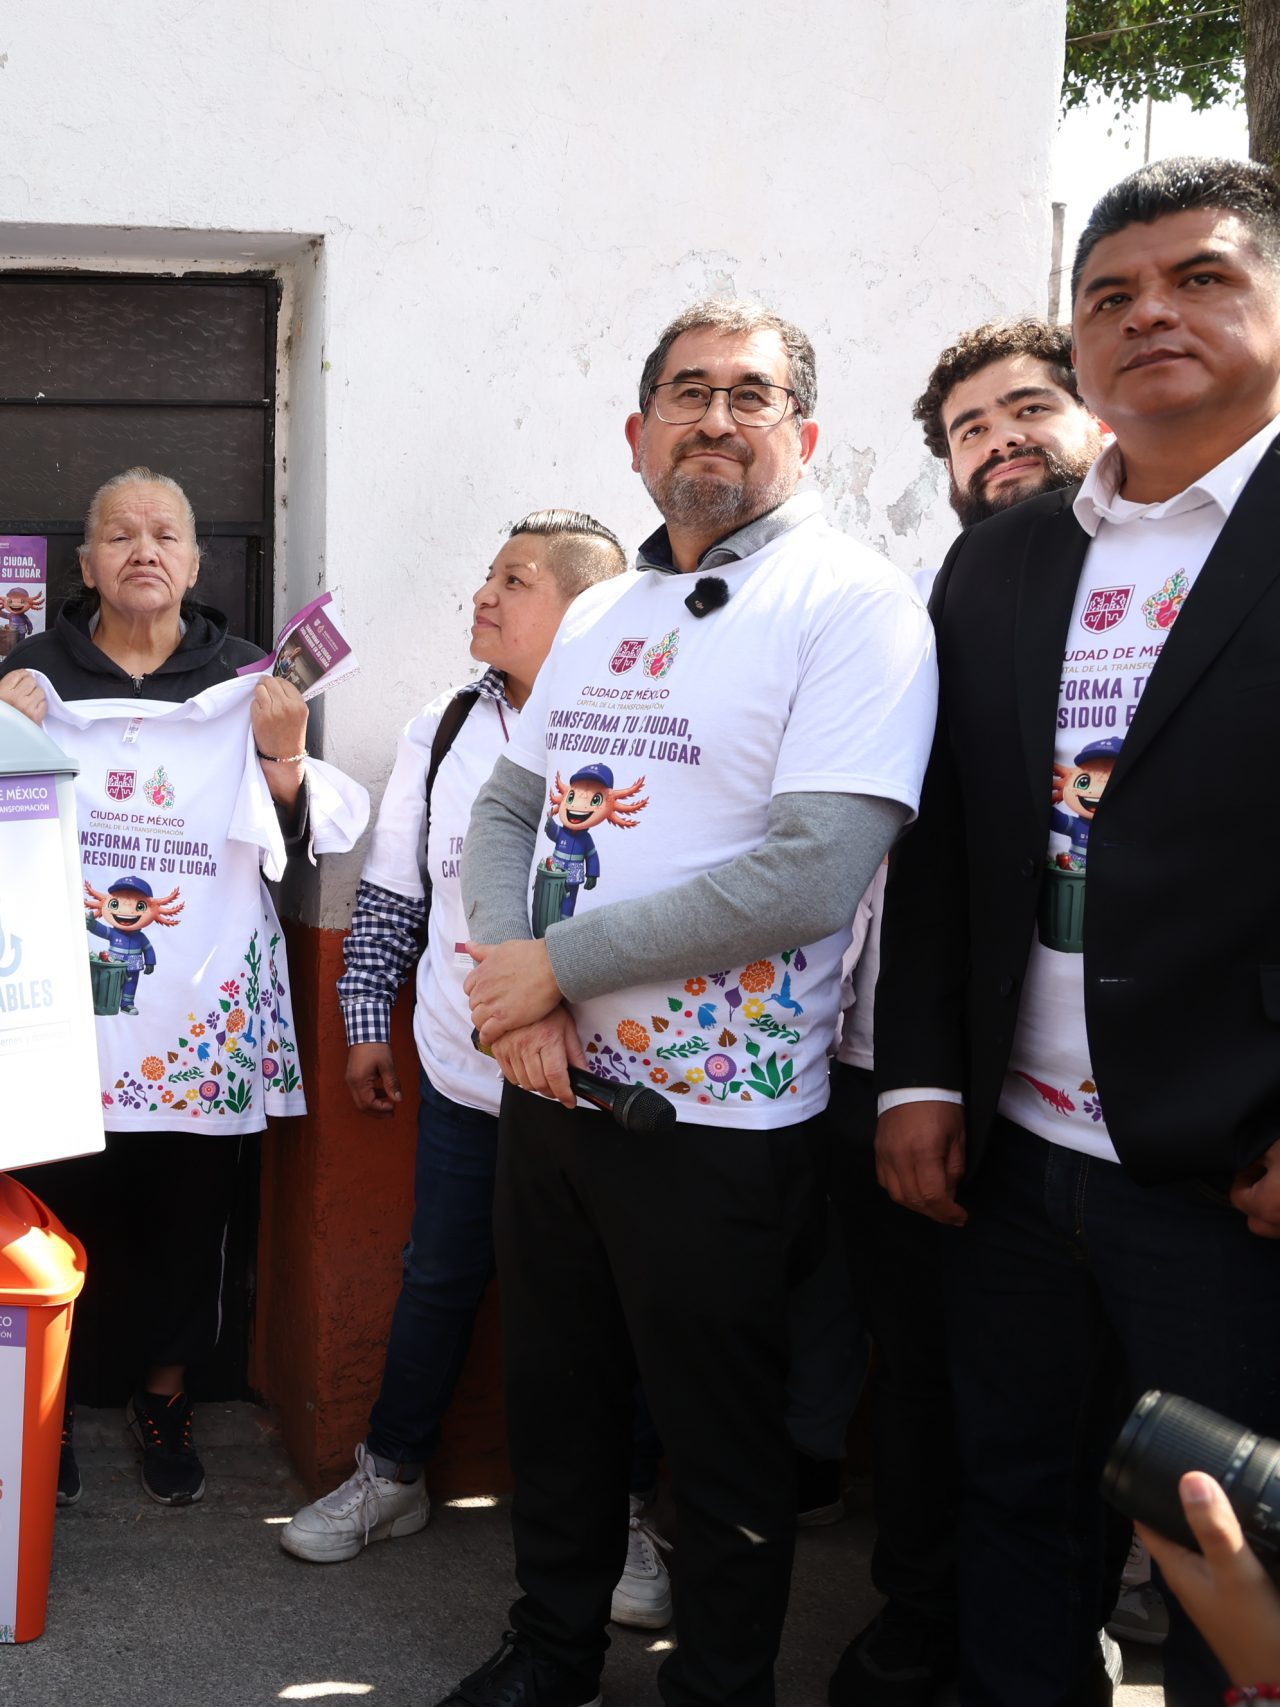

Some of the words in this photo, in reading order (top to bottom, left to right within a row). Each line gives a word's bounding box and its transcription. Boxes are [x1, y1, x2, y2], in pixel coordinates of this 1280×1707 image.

[4, 556, 36, 568] CIUDAD,
[2, 568, 13, 578] SU
[15, 568, 41, 578] LUGAR
[1113, 647, 1136, 659] DE
[582, 686, 619, 699] CIUDAD
[620, 690, 633, 700] DE
[577, 699, 598, 708] CAPITAL
[548, 711, 622, 733] TRANSFORMA
[622, 716, 639, 733] TU
[560, 734, 610, 755] RESIDUO
[610, 738, 628, 756] EN
[629, 739, 647, 757] SU
[649, 741, 701, 766] LUGAR
[7, 786, 47, 800] MÉXICO
[90, 810, 128, 822] CIUDAD
[131, 815, 144, 824] DE
[147, 815, 184, 828] MÉXICO
[89, 822, 111, 830] CAPITAL
[131, 826, 184, 836] TRANSFORMACIÓN
[80, 831, 140, 851] NSFORMA
[146, 838, 160, 853] TU
[164, 840, 213, 860] CIUDAD,
[83, 850, 136, 869] RESIDUO
[140, 856, 155, 871] EN
[160, 858, 176, 873] SU
[180, 860, 217, 877] LUGAR
